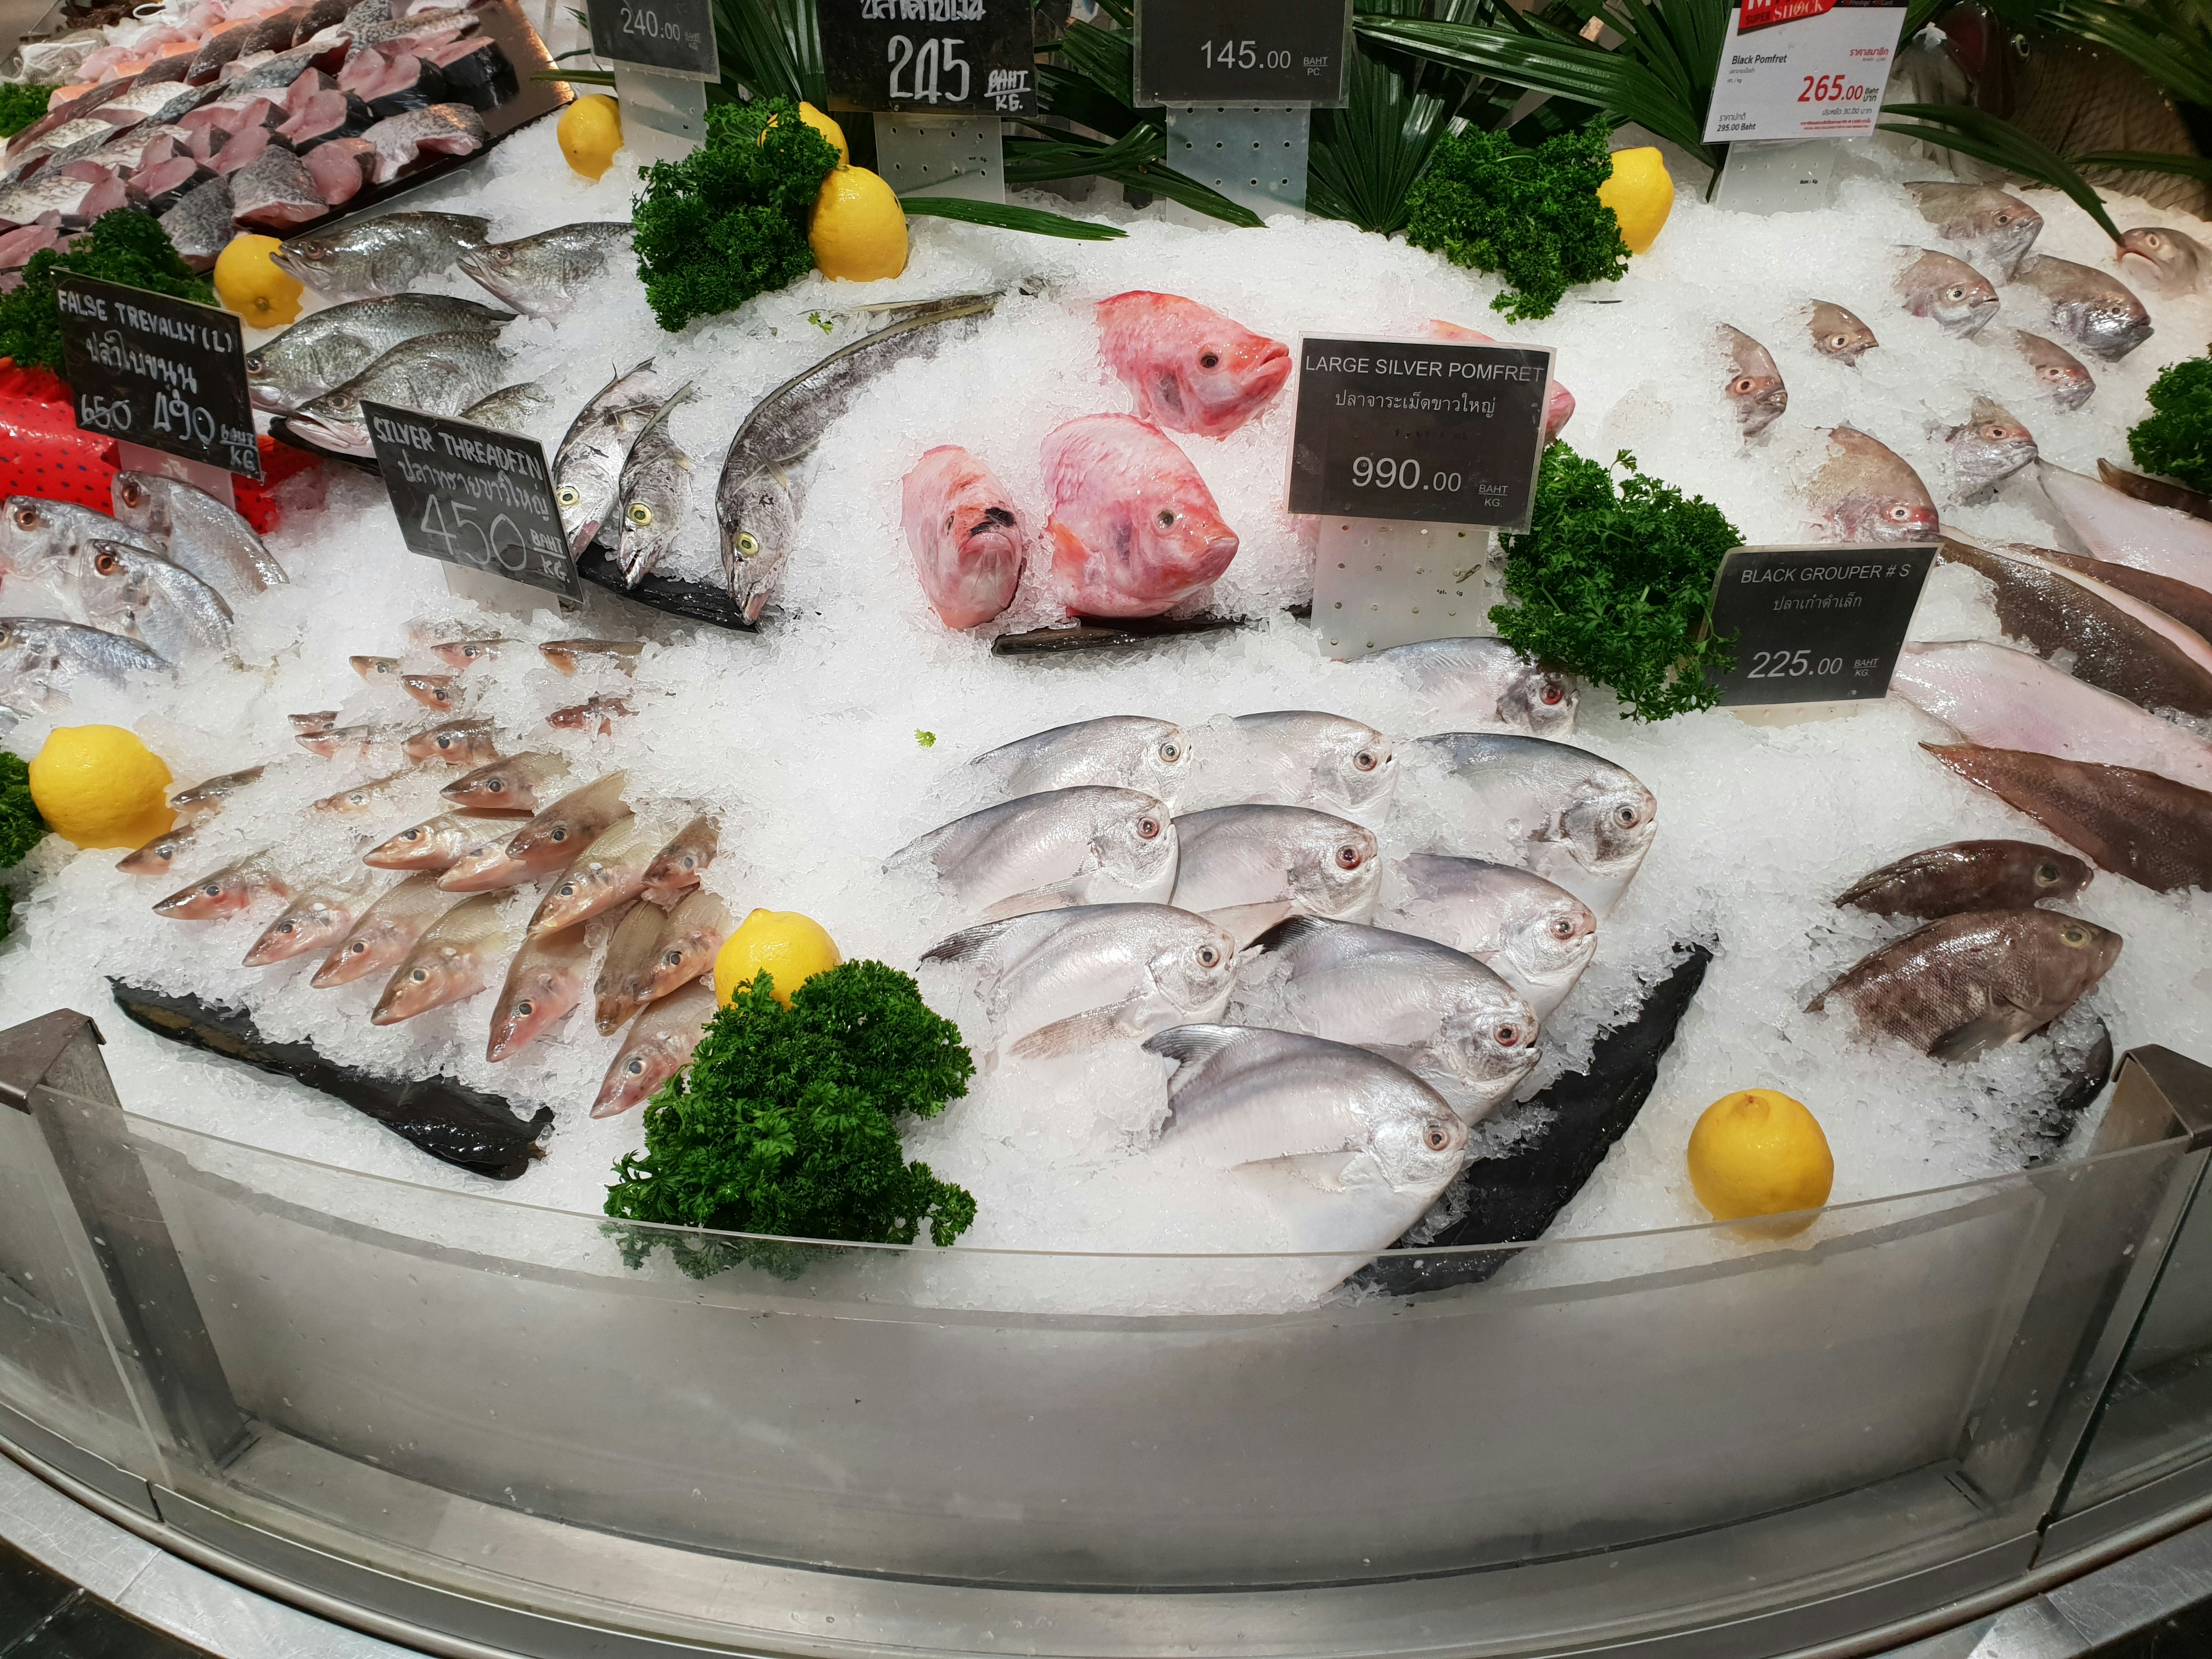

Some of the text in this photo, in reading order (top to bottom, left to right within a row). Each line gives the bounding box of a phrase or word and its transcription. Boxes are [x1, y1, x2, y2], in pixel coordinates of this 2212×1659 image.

[1200, 40, 1291, 69] 145.00
[1304, 57, 1328, 65] BAHT
[1731, 54, 1787, 65] Black Pomfret
[888, 35, 970, 104] 245
[988, 69, 1029, 93] BAHT
[1797, 75, 1863, 102] 265.00
[996, 94, 1024, 111] KG.
[1717, 123, 1740, 132] 295.00
[58, 290, 232, 353] FALSE TREVALLY (L)
[1306, 356, 1544, 383] LARGE SILVER POMFRET
[154, 389, 215, 445] 490
[1335, 390, 1496, 418] ปลาจาระเม็ดขาวใหญ่
[373, 417, 543, 481] SILVER THREADFIN
[1352, 456, 1462, 492] 990.00
[1479, 484, 1508, 494] BAHT
[1484, 498, 1502, 507] KG.
[421, 494, 527, 572] 450
[529, 528, 562, 555] BAHT
[541, 555, 571, 584] KG.
[1741, 568, 1797, 583] BLACK
[1800, 566, 1882, 581] GROUPER
[1773, 591, 1862, 611] ปลาเก๋าดำเล็ก
[1747, 650, 1843, 679] 225.00
[1854, 658, 1879, 667] BAHT
